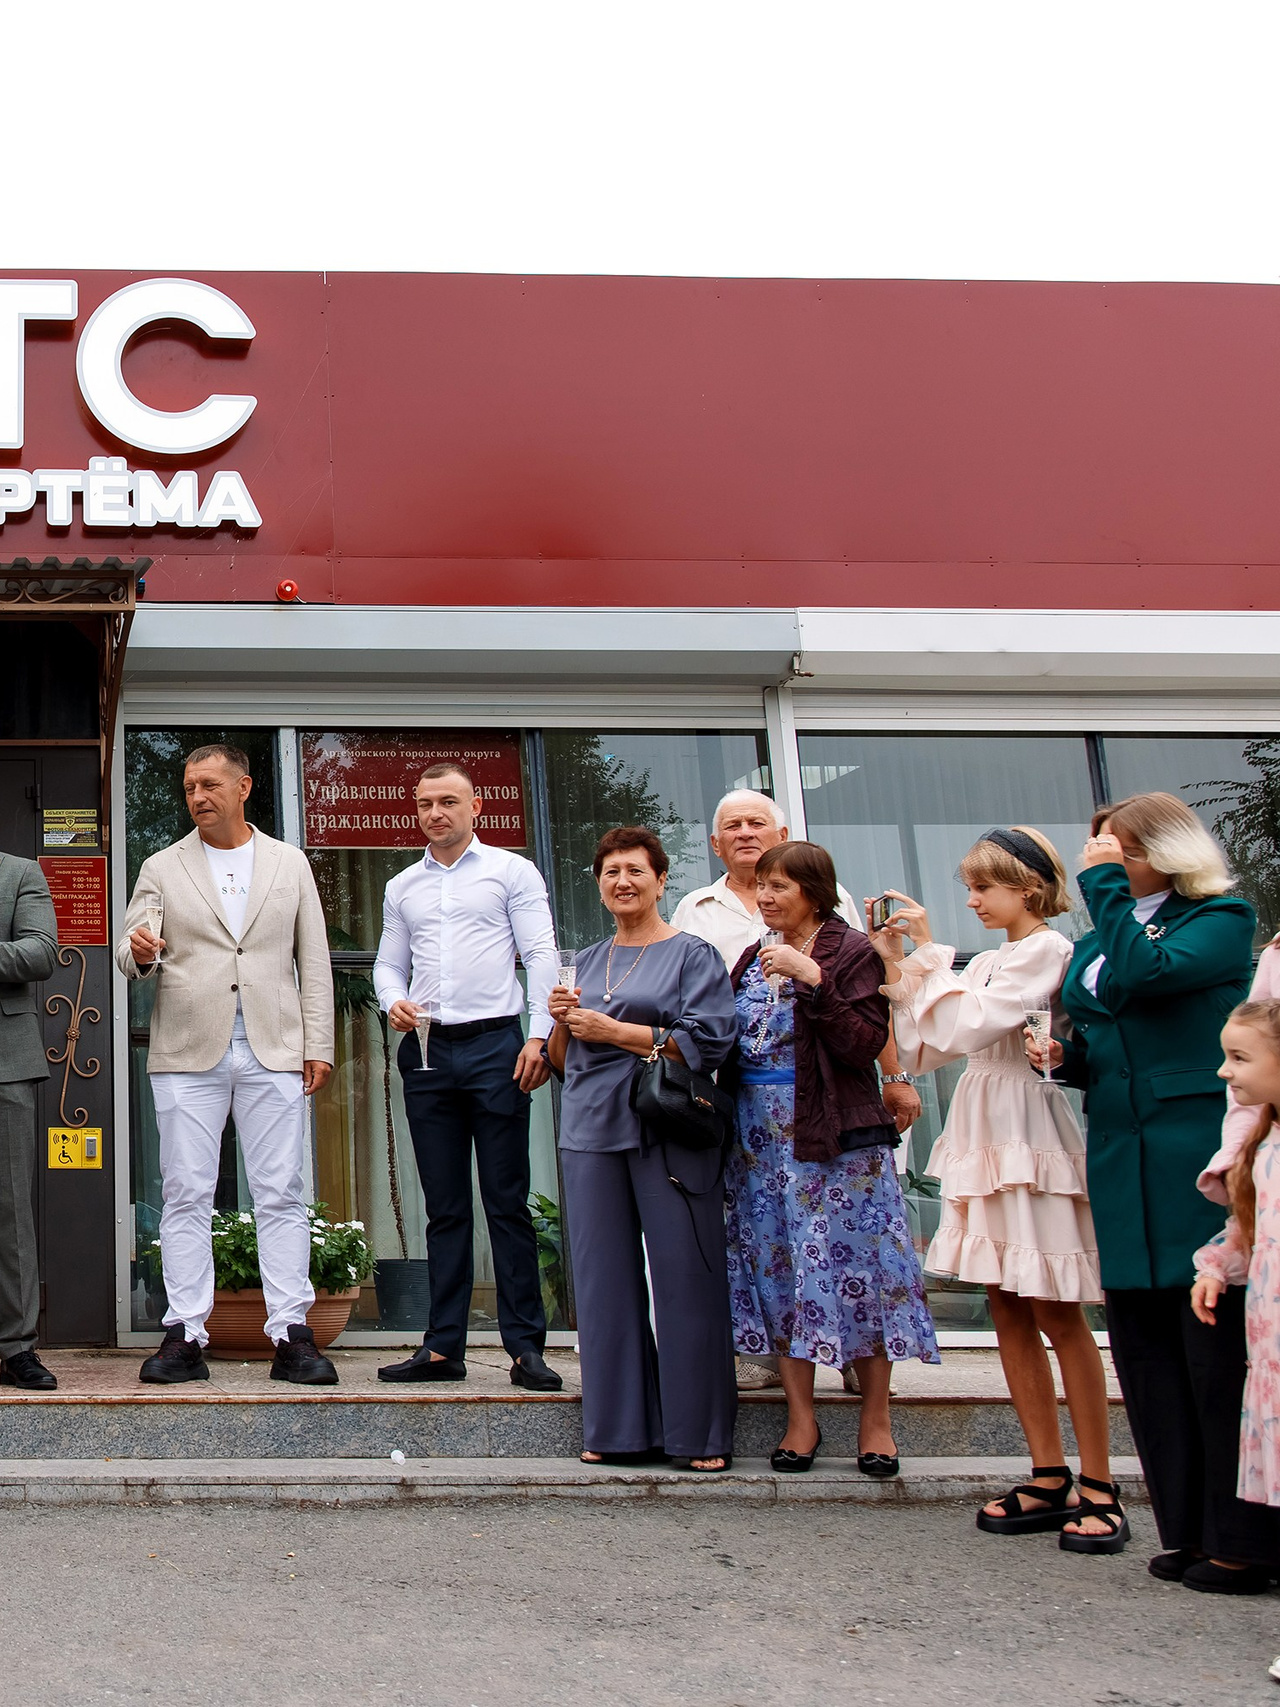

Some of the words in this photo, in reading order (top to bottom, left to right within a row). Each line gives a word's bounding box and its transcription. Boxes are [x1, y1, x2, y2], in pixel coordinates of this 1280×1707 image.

[400, 750, 461, 759] городского
[464, 750, 501, 759] округа
[307, 779, 406, 806] Управление
[474, 785, 519, 800] актов
[309, 813, 419, 834] гражданског
[471, 815, 521, 829] ояния
